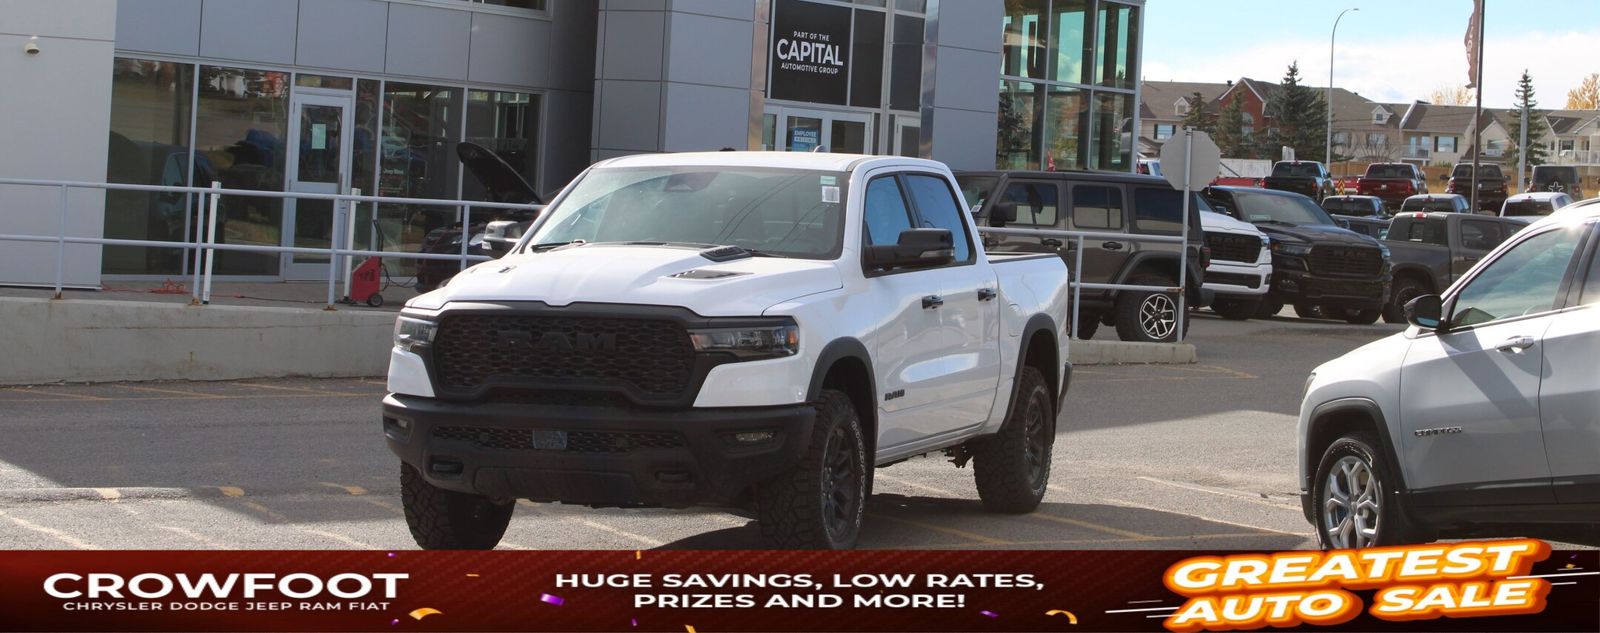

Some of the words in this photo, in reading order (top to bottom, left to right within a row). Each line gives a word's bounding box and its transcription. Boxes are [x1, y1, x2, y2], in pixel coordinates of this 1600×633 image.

[793, 30, 808, 39] PART
[809, 32, 818, 40] OF
[818, 33, 830, 42] THE
[776, 38, 844, 66] CAPITAL
[780, 62, 818, 73] AUTOMOTIVE
[818, 66, 839, 75] GROUP
